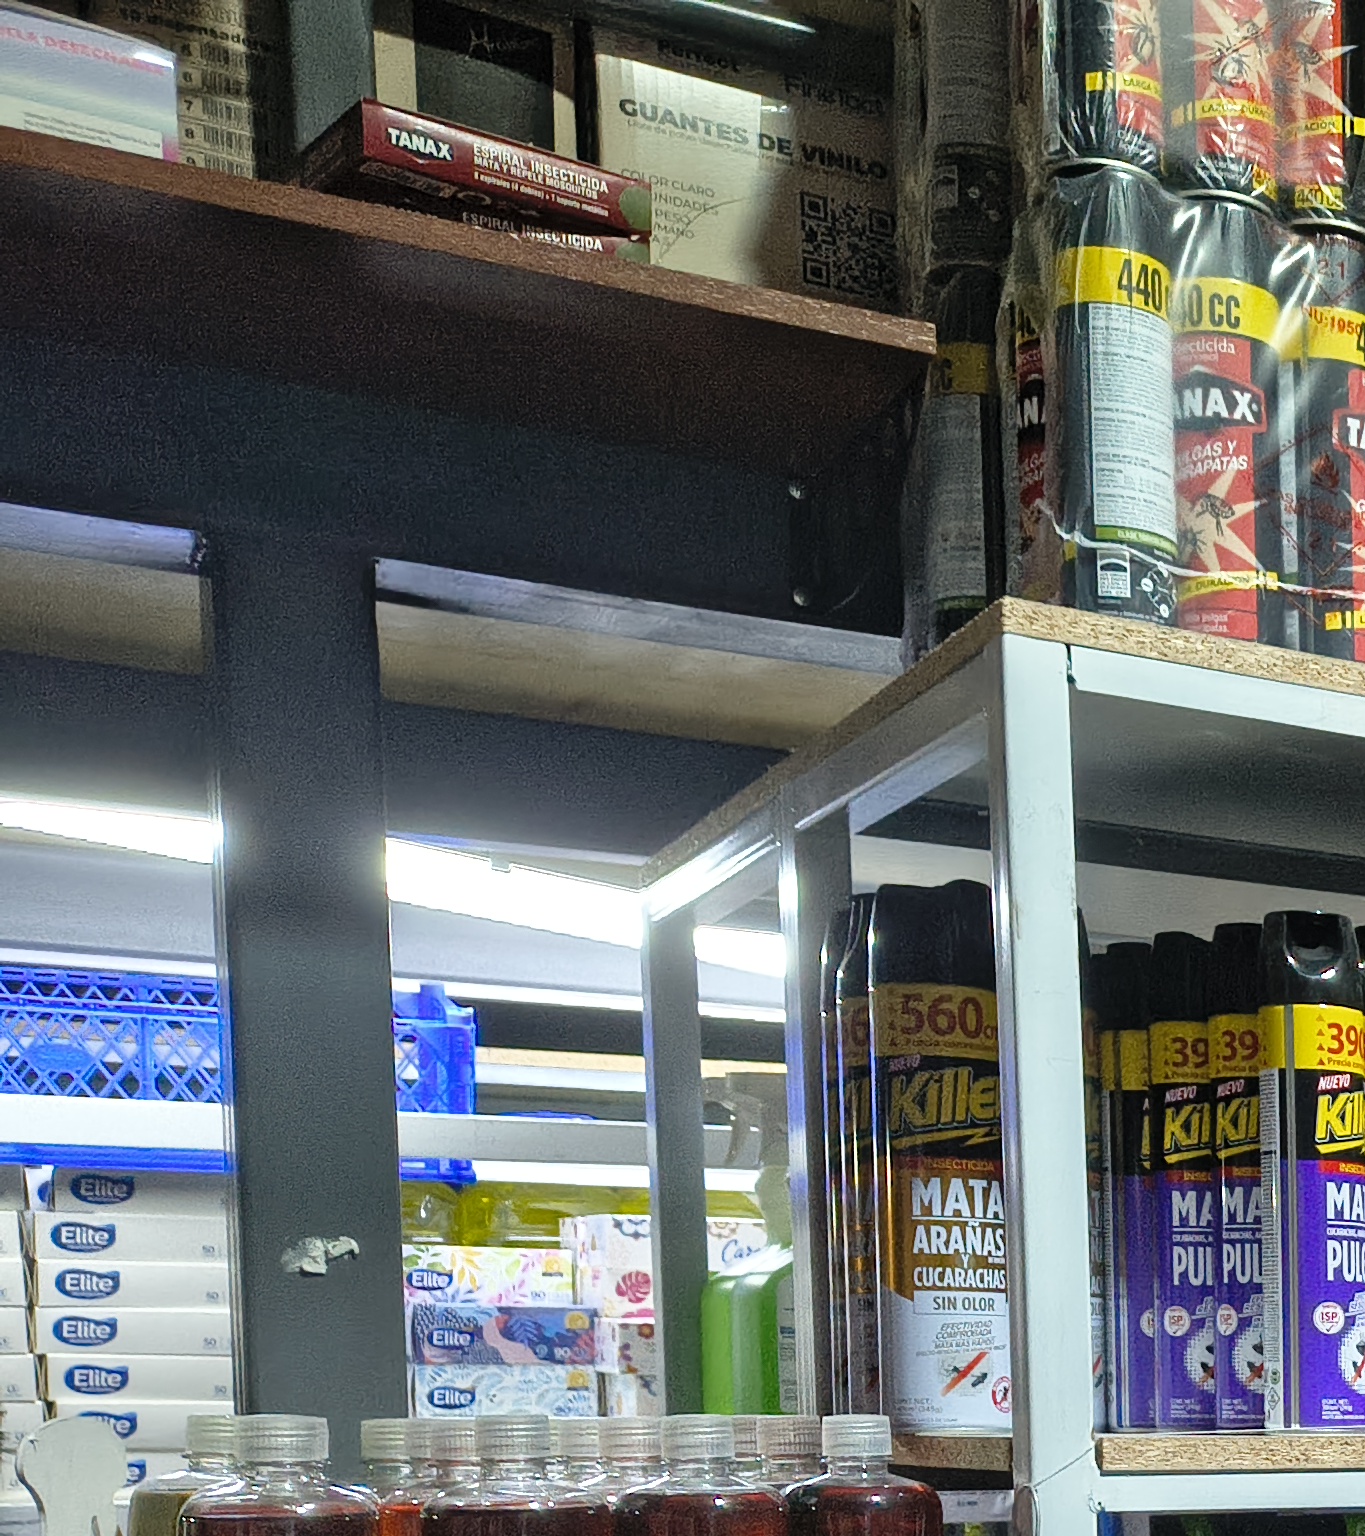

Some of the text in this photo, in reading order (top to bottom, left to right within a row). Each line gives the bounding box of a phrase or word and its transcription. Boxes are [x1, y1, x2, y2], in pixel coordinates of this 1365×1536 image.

[388, 128, 453, 161] TANAX
[619, 98, 887, 180] GUANTES DE VINILO
[473, 143, 527, 170] ESPIRAL
[531, 160, 608, 194] INSECTICIDA
[1117, 257, 1163, 314] 440
[1318, 1074, 1350, 1091] NUEVO
[911, 1176, 1005, 1217] MATA
[58, 1226, 110, 1249] Elite
[913, 1219, 1005, 1258] ARAÑAS
[63, 1273, 116, 1295] Elite
[410, 1271, 450, 1290] Elite
[913, 1268, 1006, 1289] CUCARACHAS
[932, 1296, 995, 1312] SIN OLOR
[60, 1319, 112, 1342] Elite
[72, 1367, 123, 1390] Elite
